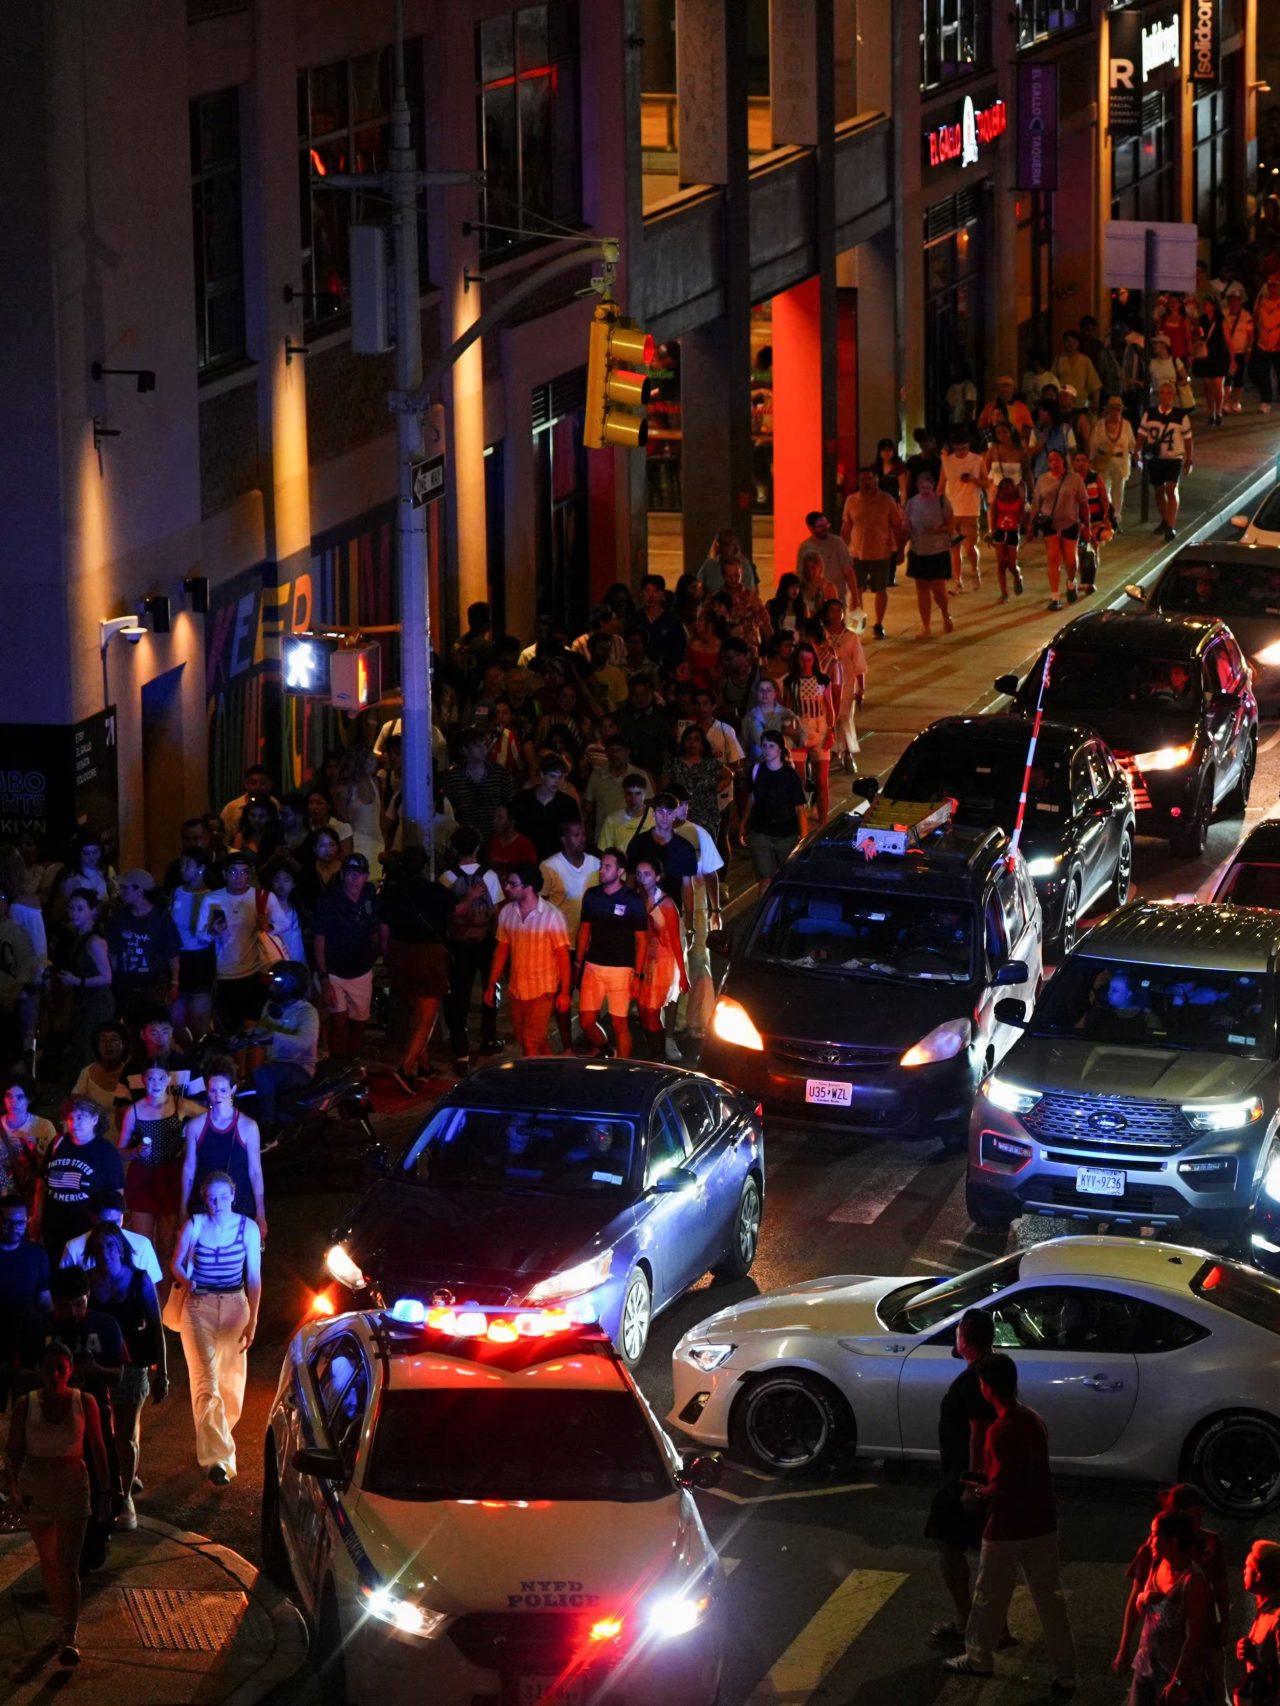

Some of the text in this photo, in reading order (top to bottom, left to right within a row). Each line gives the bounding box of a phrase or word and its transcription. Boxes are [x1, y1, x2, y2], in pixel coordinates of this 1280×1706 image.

[1109, 58, 1134, 89] R
[1031, 69, 1042, 116] EL GALLO
[1031, 136, 1042, 184] TAQUERIA
[53, 1192, 90, 1202] AMERICA
[520, 1581, 583, 1592] NYPD
[507, 1594, 600, 1608] POLICE
